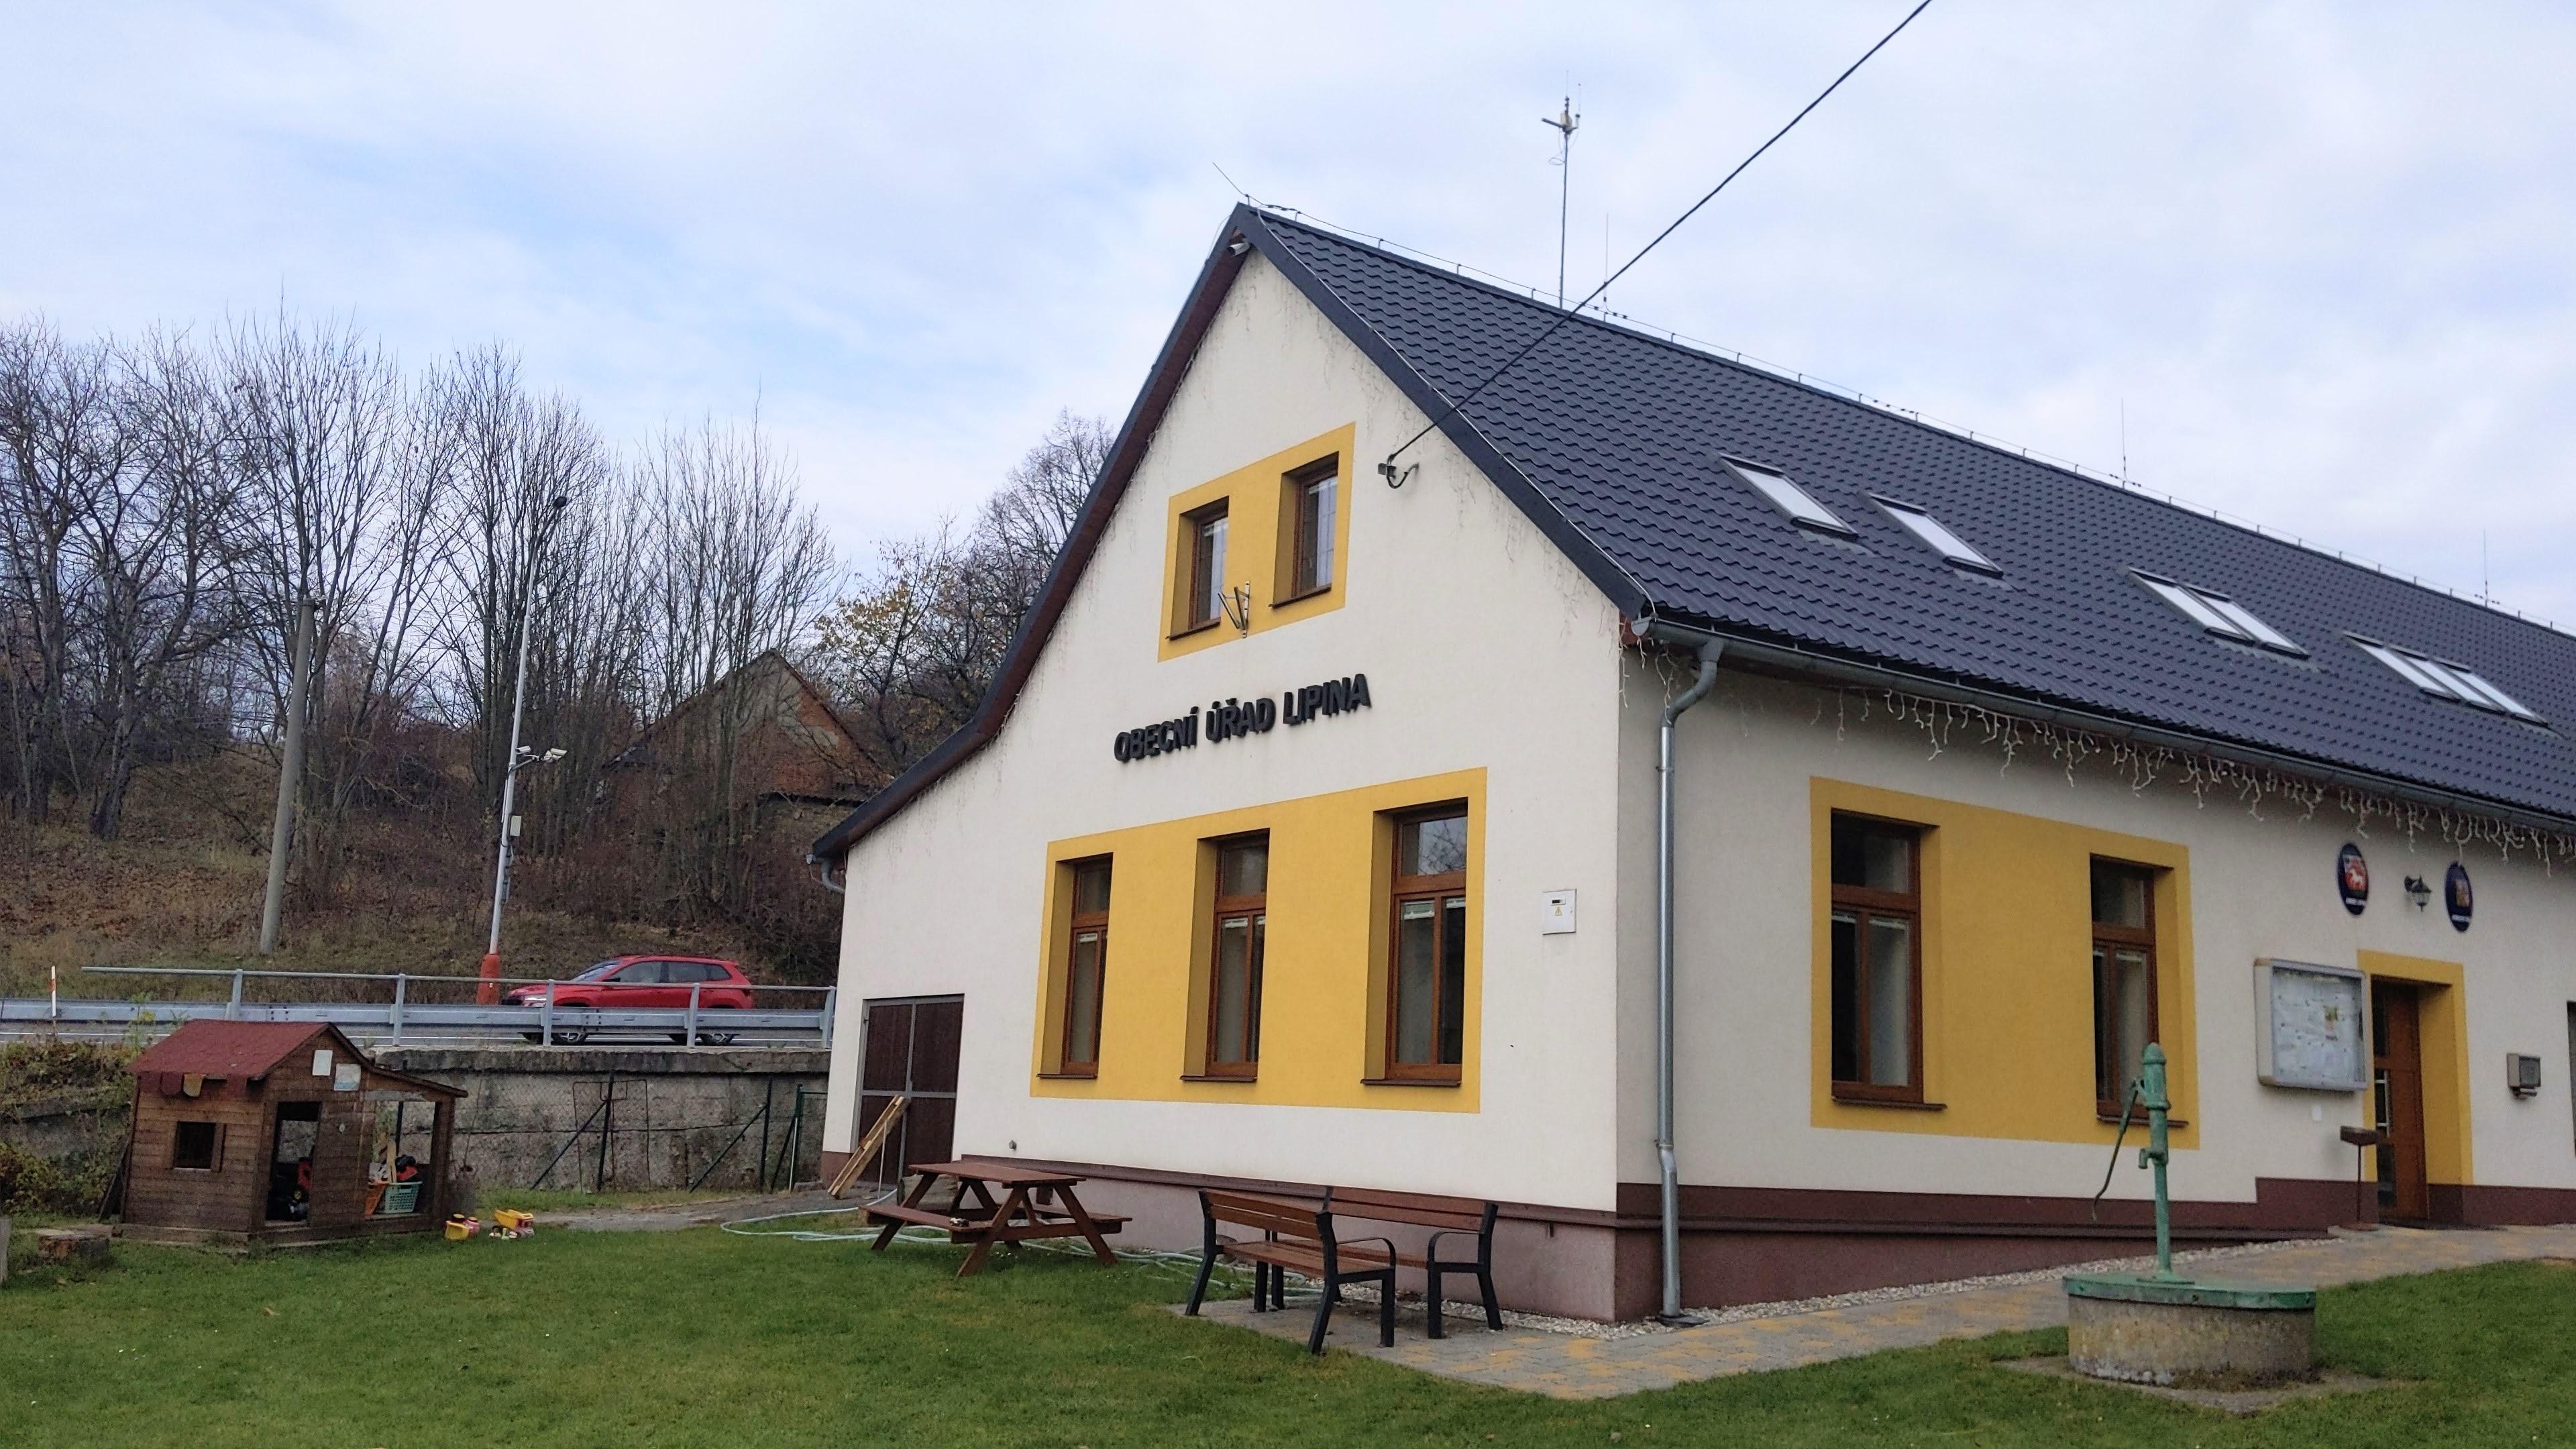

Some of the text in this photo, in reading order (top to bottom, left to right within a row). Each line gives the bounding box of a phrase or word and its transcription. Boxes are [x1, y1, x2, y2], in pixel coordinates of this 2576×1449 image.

[1114, 674, 1371, 762] OBECNÍ ÚŘAD LIPINA
